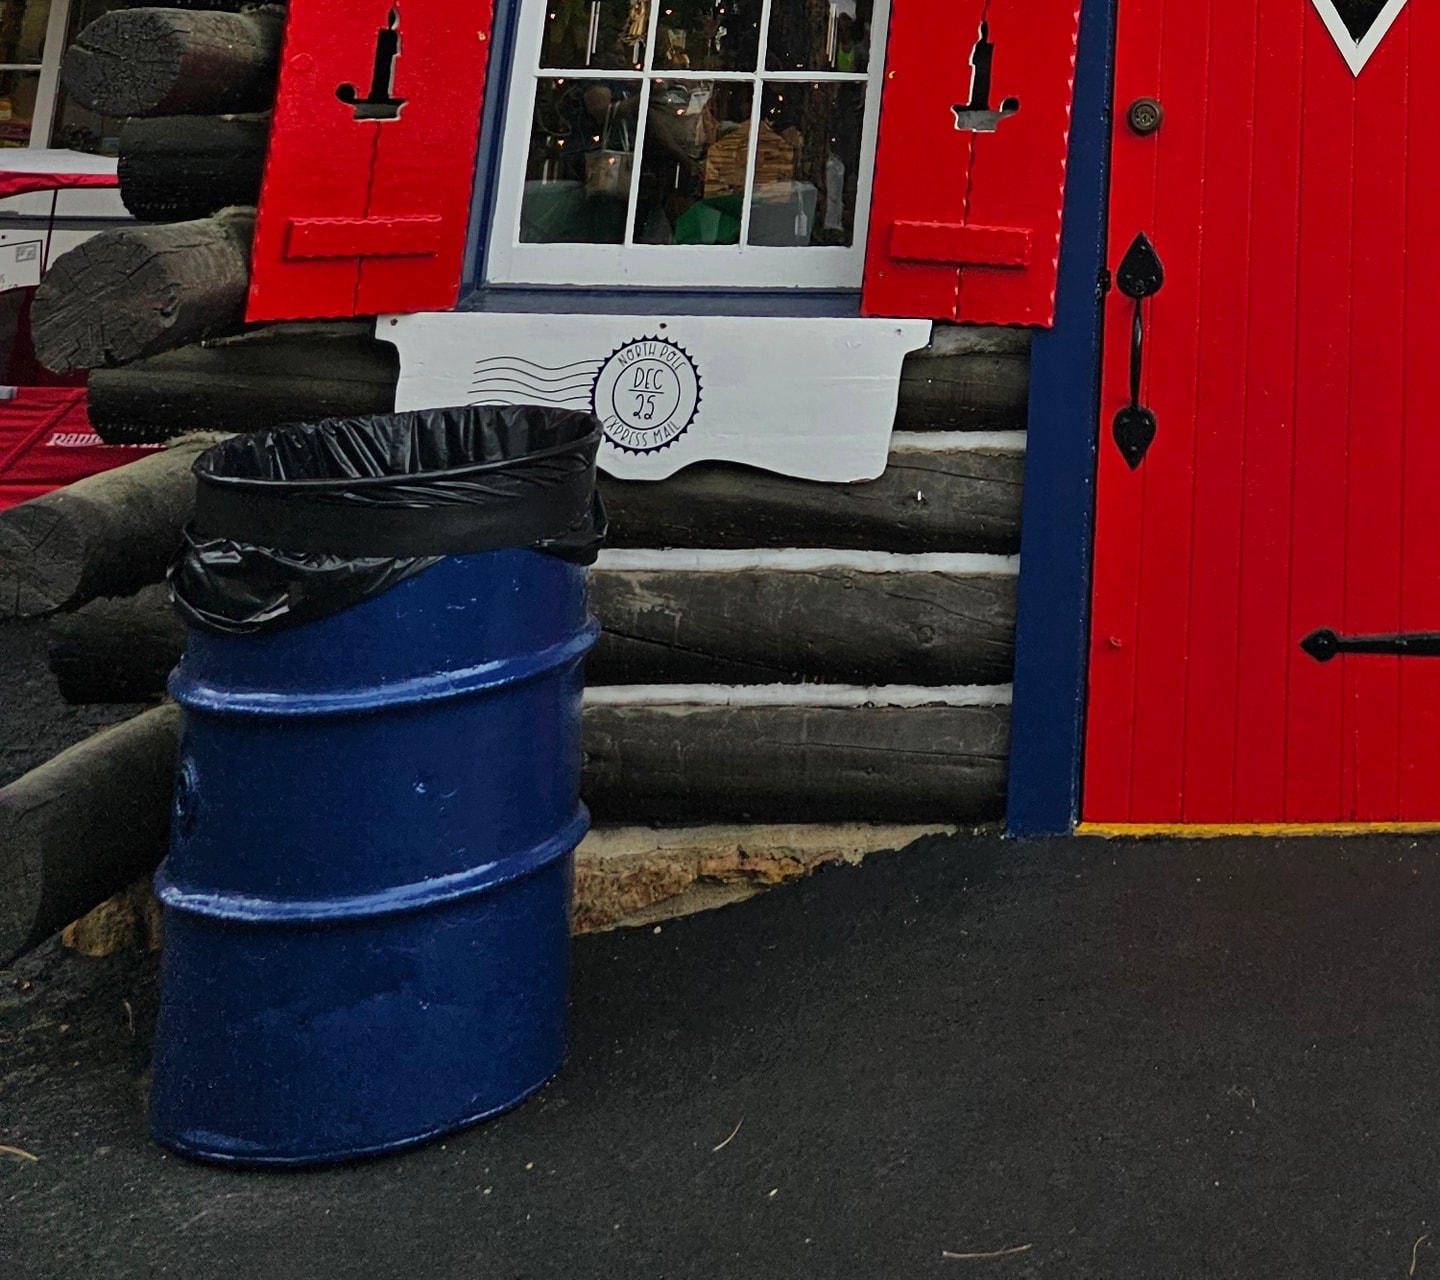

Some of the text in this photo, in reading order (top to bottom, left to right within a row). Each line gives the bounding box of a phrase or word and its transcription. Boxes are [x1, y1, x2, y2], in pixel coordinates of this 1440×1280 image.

[617, 342, 687, 371] NORTH POLE
[633, 366, 664, 391] DEC
[632, 393, 657, 420] 25
[603, 414, 681, 448] EXPRESS MAIL
